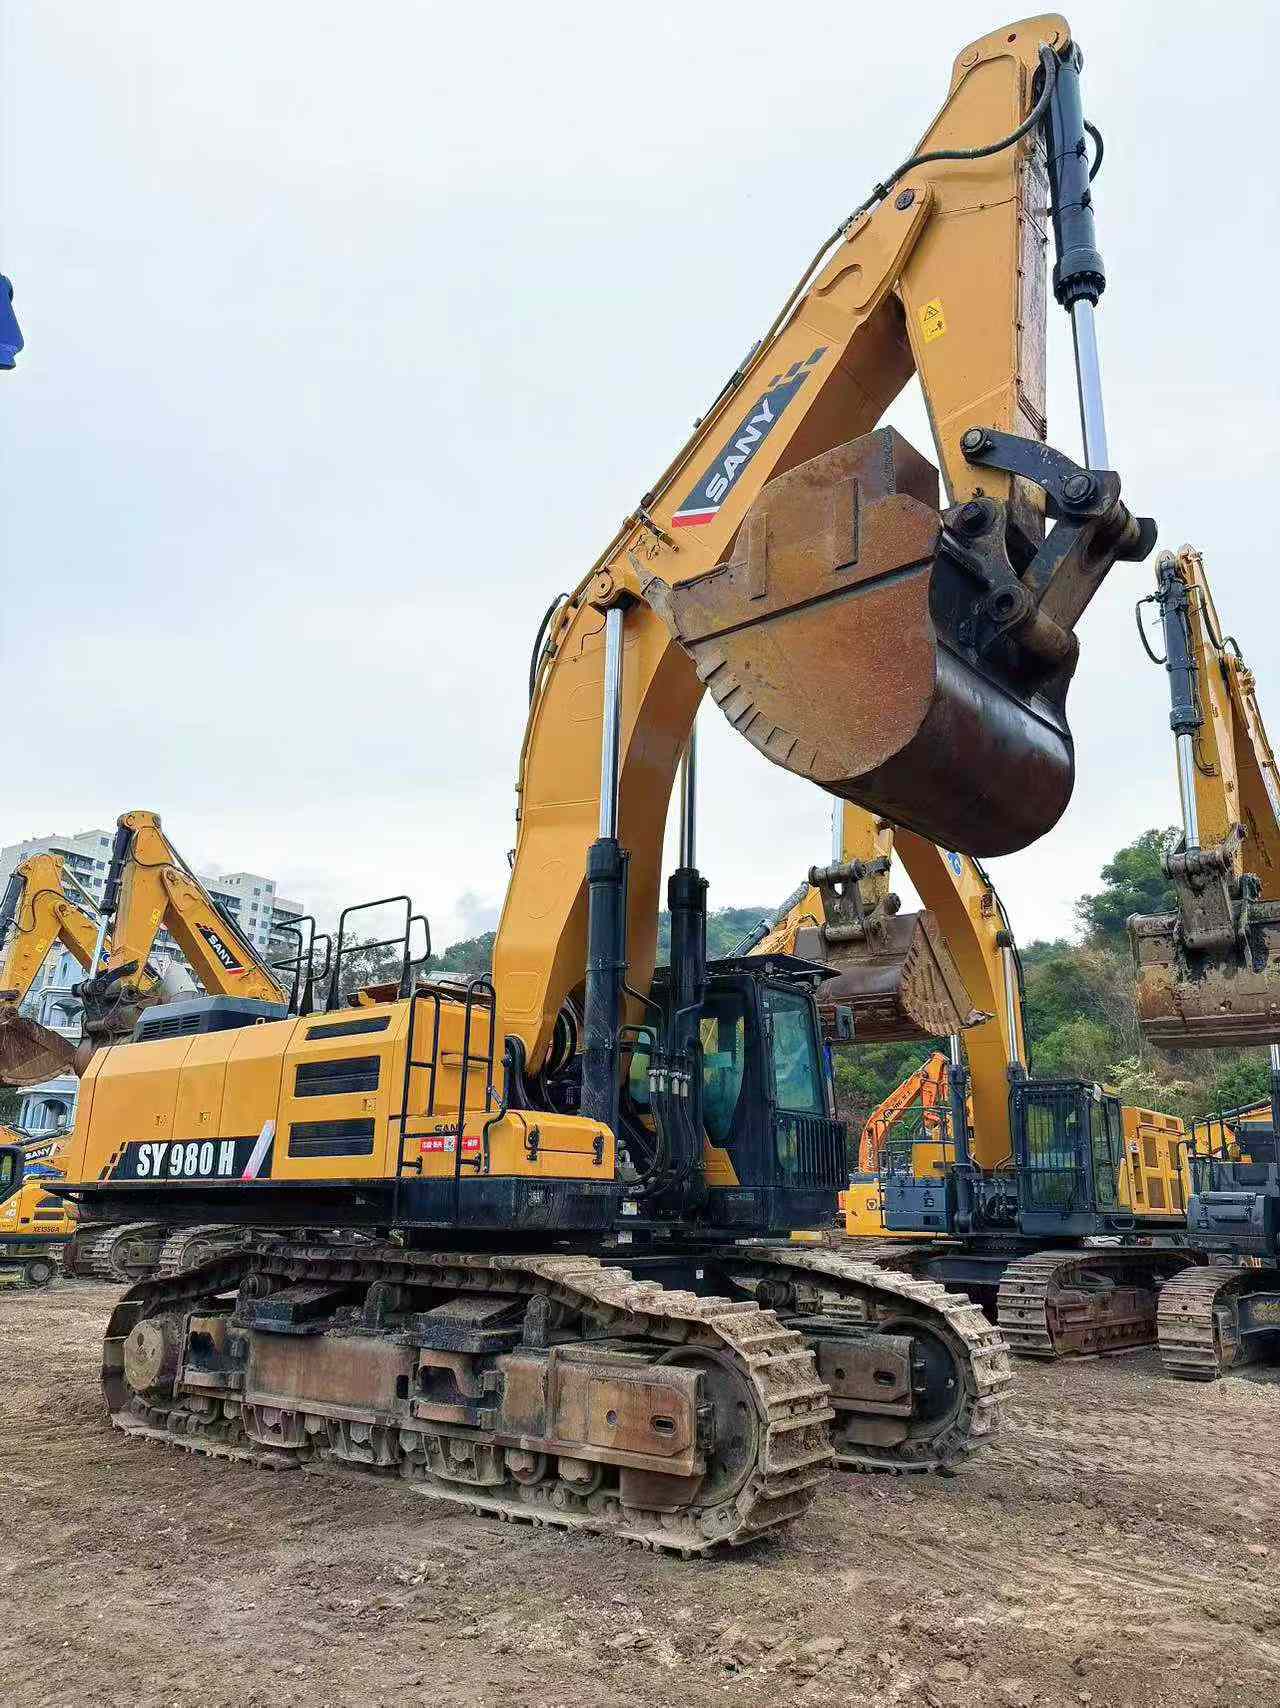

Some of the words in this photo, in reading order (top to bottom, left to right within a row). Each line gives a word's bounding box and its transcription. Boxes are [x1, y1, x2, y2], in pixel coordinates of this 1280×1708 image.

[705, 397, 776, 503] SANY
[208, 934, 234, 965] SANY
[24, 1146, 51, 1160] SANY
[136, 1142, 169, 1176] SY
[169, 1141, 214, 1176] 980
[217, 1140, 236, 1175] H
